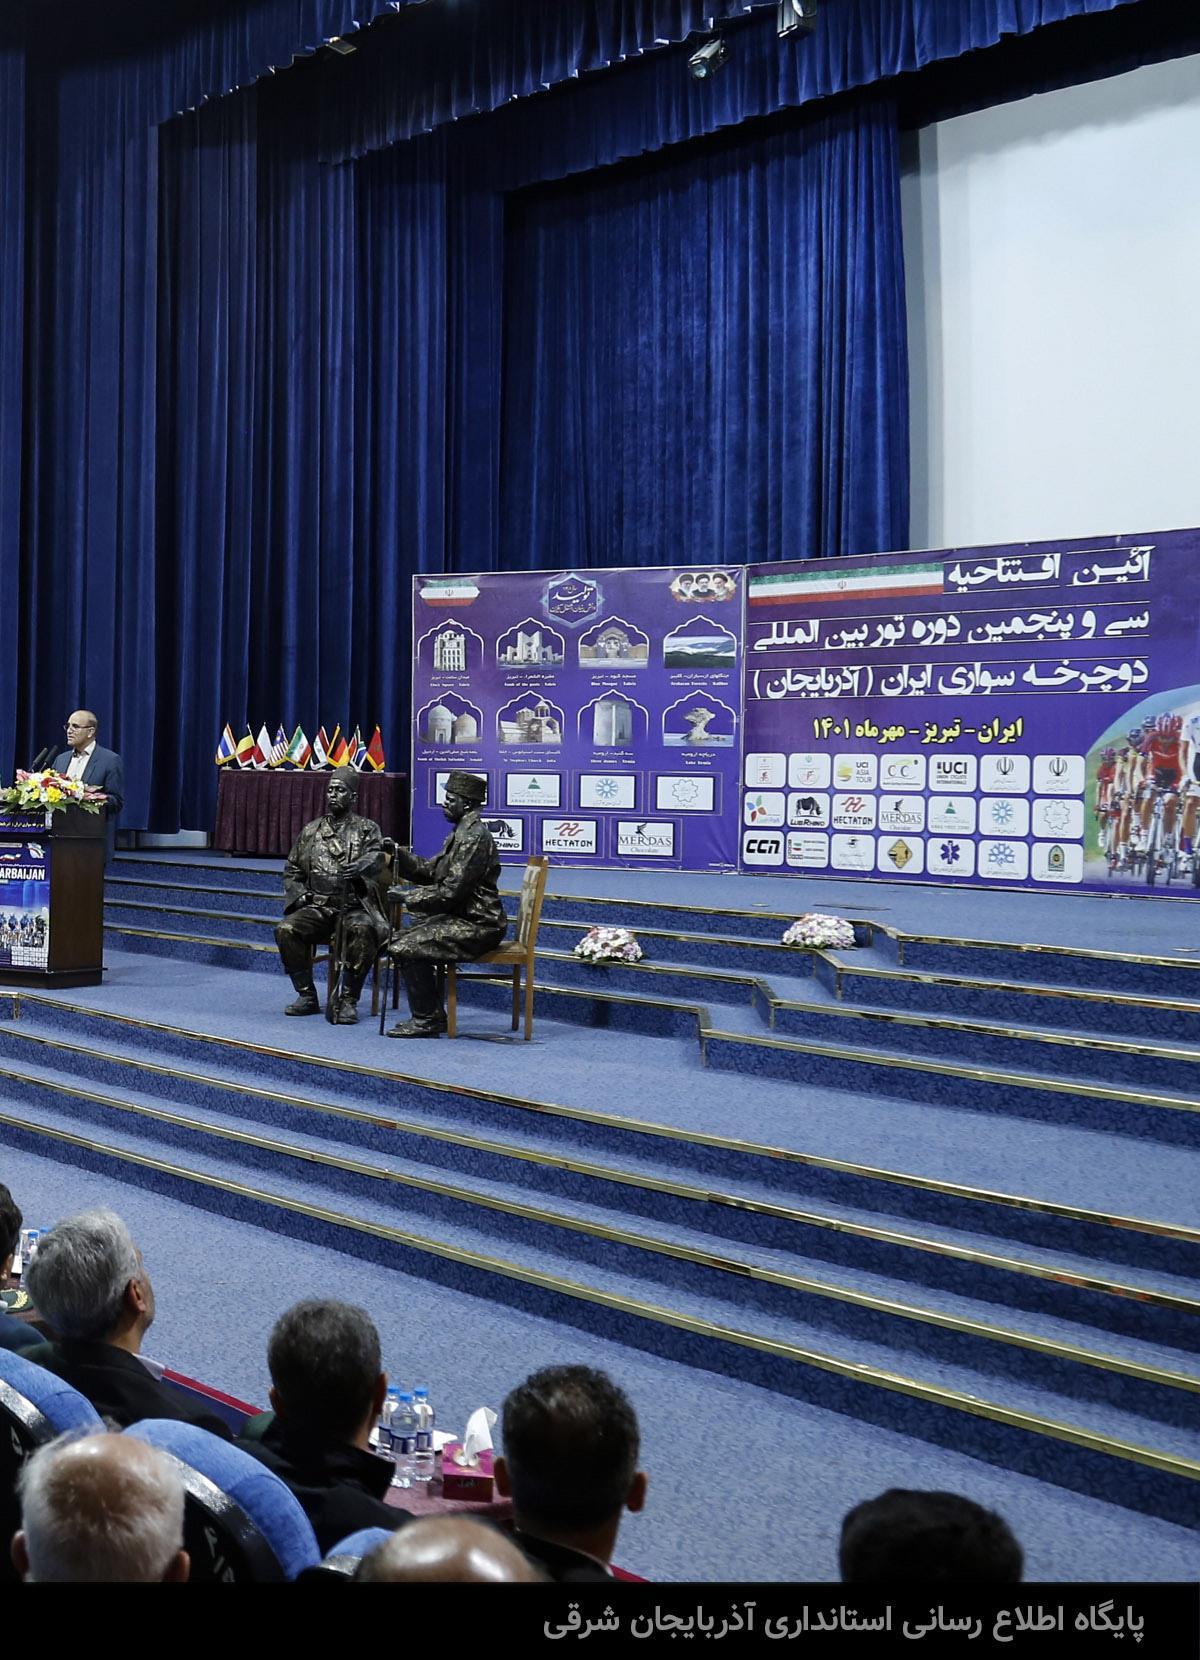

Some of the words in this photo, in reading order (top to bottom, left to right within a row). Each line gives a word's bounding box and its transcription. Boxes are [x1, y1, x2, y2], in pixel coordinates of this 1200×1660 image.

[948, 553, 1061, 592] افتتاحیه
[1073, 546, 1155, 585] آئین
[753, 620, 820, 651] المللی
[825, 623, 869, 649] بین
[874, 615, 906, 647] تور
[912, 615, 961, 645] دوره
[967, 610, 1074, 642] پنجمین
[1076, 609, 1097, 639] و
[1104, 610, 1149, 636] سی
[881, 664, 932, 696] ایران
[938, 662, 1015, 695] سواری
[1022, 659, 1149, 692] دوچرخه
[813, 717, 850, 740] ۱۴۰۱
[921, 719, 962, 744] تبریز
[977, 717, 1024, 744] ایران
[942, 761, 967, 774] UCI
[833, 816, 873, 826] HECTATON
[545, 839, 593, 848] HECTATON
